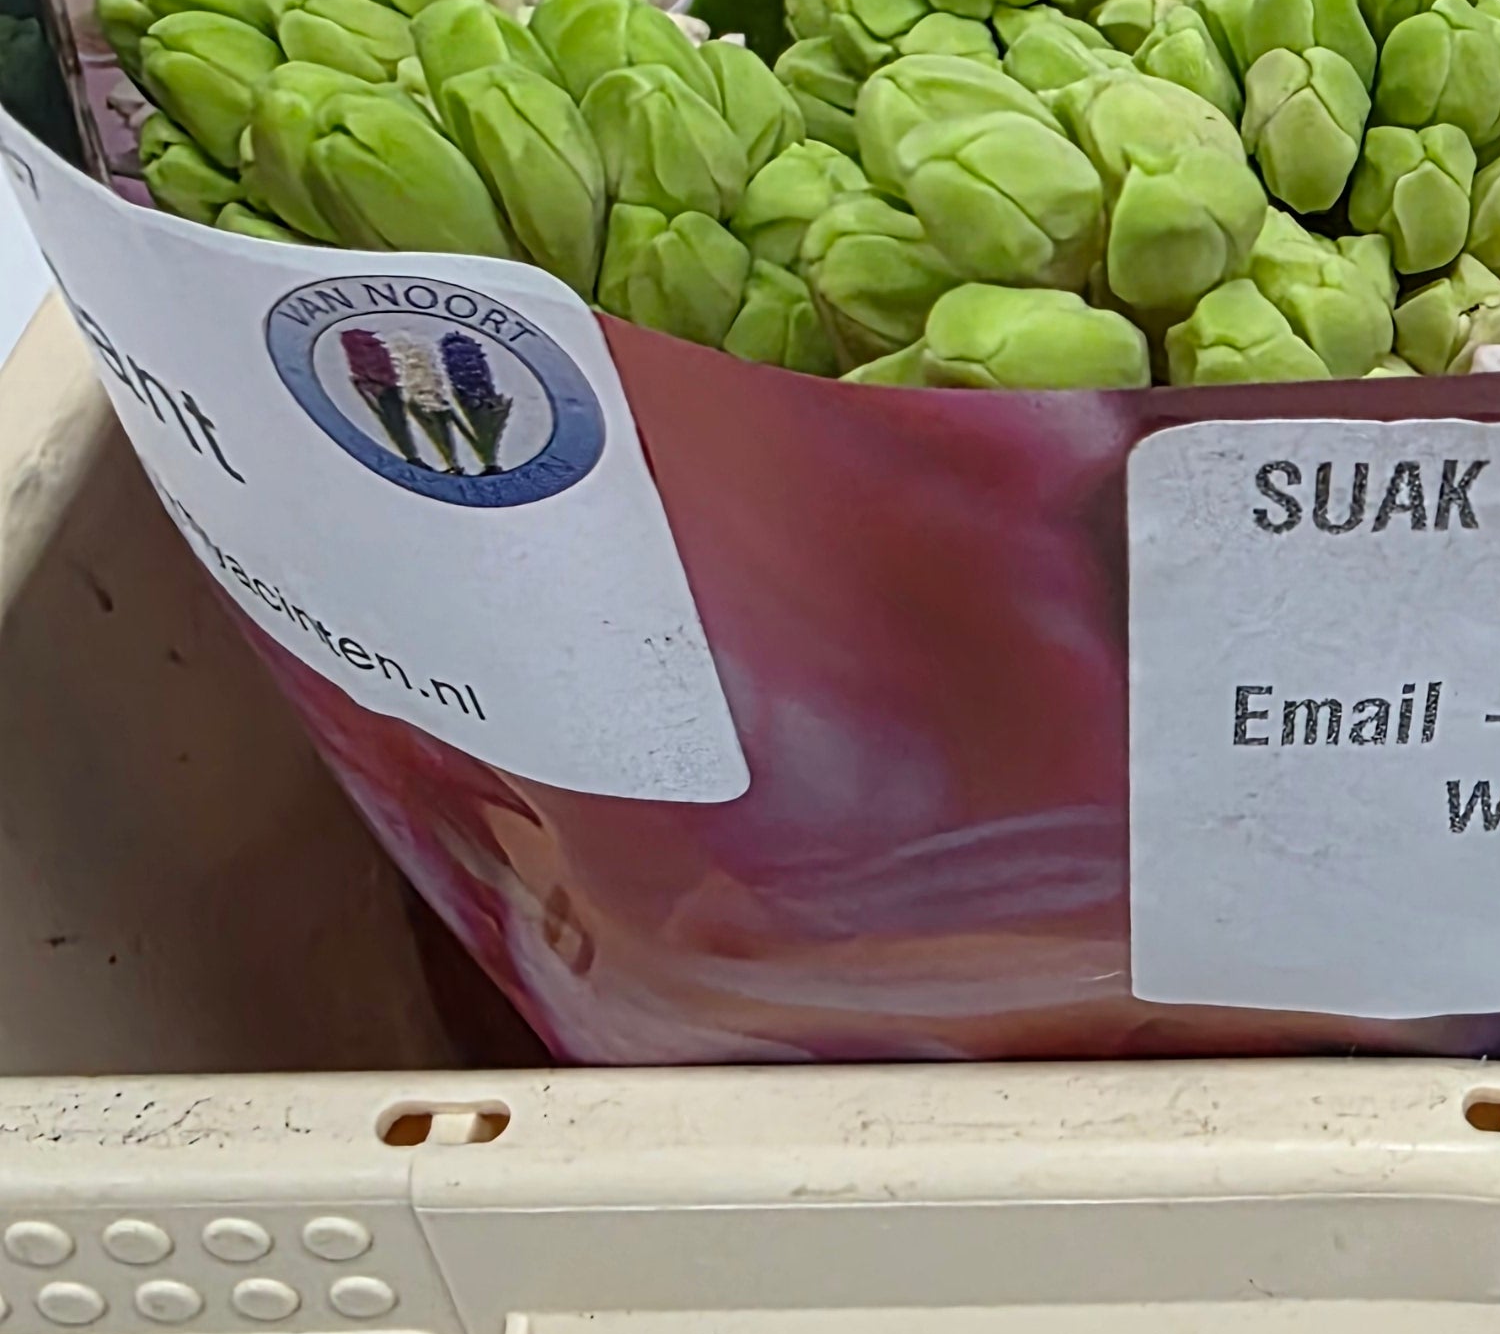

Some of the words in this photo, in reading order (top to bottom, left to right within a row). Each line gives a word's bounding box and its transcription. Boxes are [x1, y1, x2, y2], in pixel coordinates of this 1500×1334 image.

[276, 285, 357, 327] VAN
[361, 282, 539, 342] NOORT
[1253, 460, 1490, 534] SUAK
[1233, 681, 1442, 746] Email
